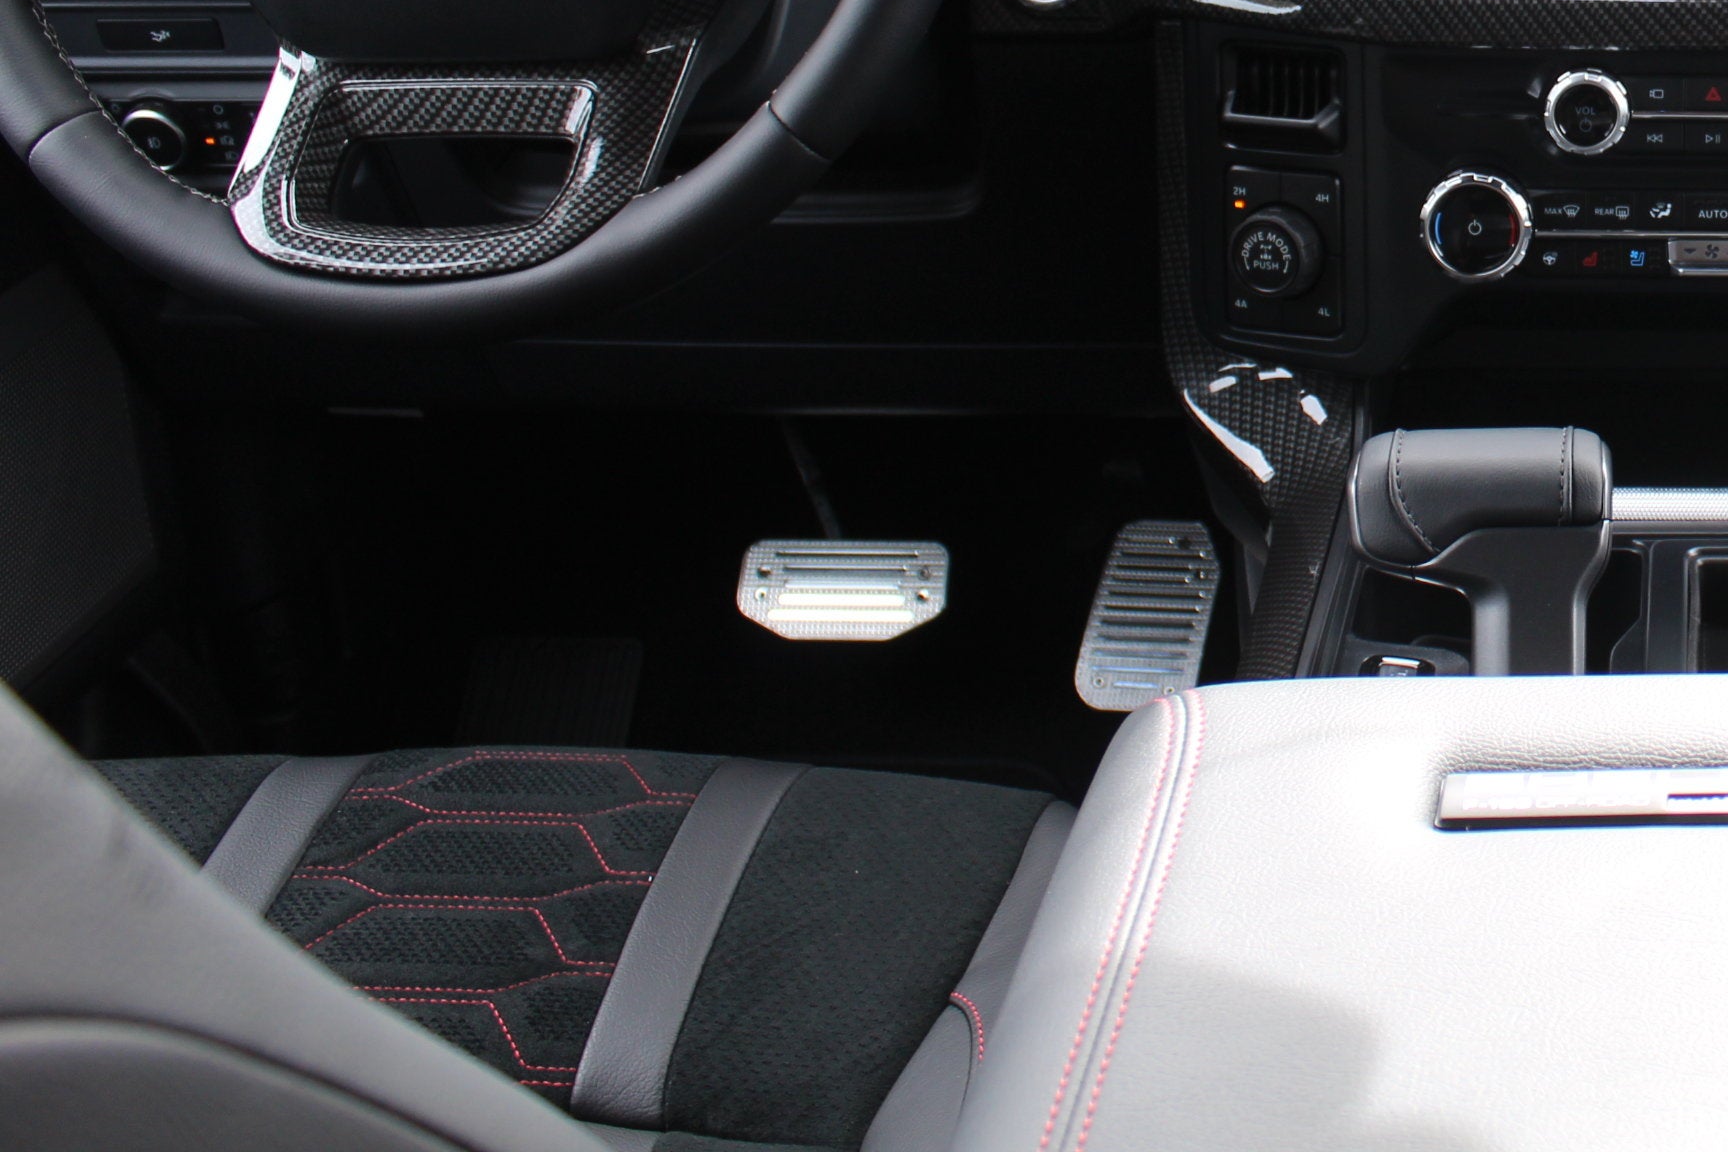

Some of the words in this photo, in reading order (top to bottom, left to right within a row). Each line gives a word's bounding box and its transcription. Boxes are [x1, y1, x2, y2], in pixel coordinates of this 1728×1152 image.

[1574, 105, 1596, 117] VOL
[1232, 186, 1246, 196] 2H
[1315, 192, 1330, 203] 4H
[1544, 206, 1564, 216] MAX
[1594, 206, 1614, 216] REAR
[1698, 209, 1728, 219] AUTO
[1240, 231, 1265, 258] DRIVE
[1265, 231, 1292, 262] MODE
[1252, 259, 1279, 271] PUSH
[1234, 298, 1248, 310] 4A
[1317, 306, 1331, 318] 4L
